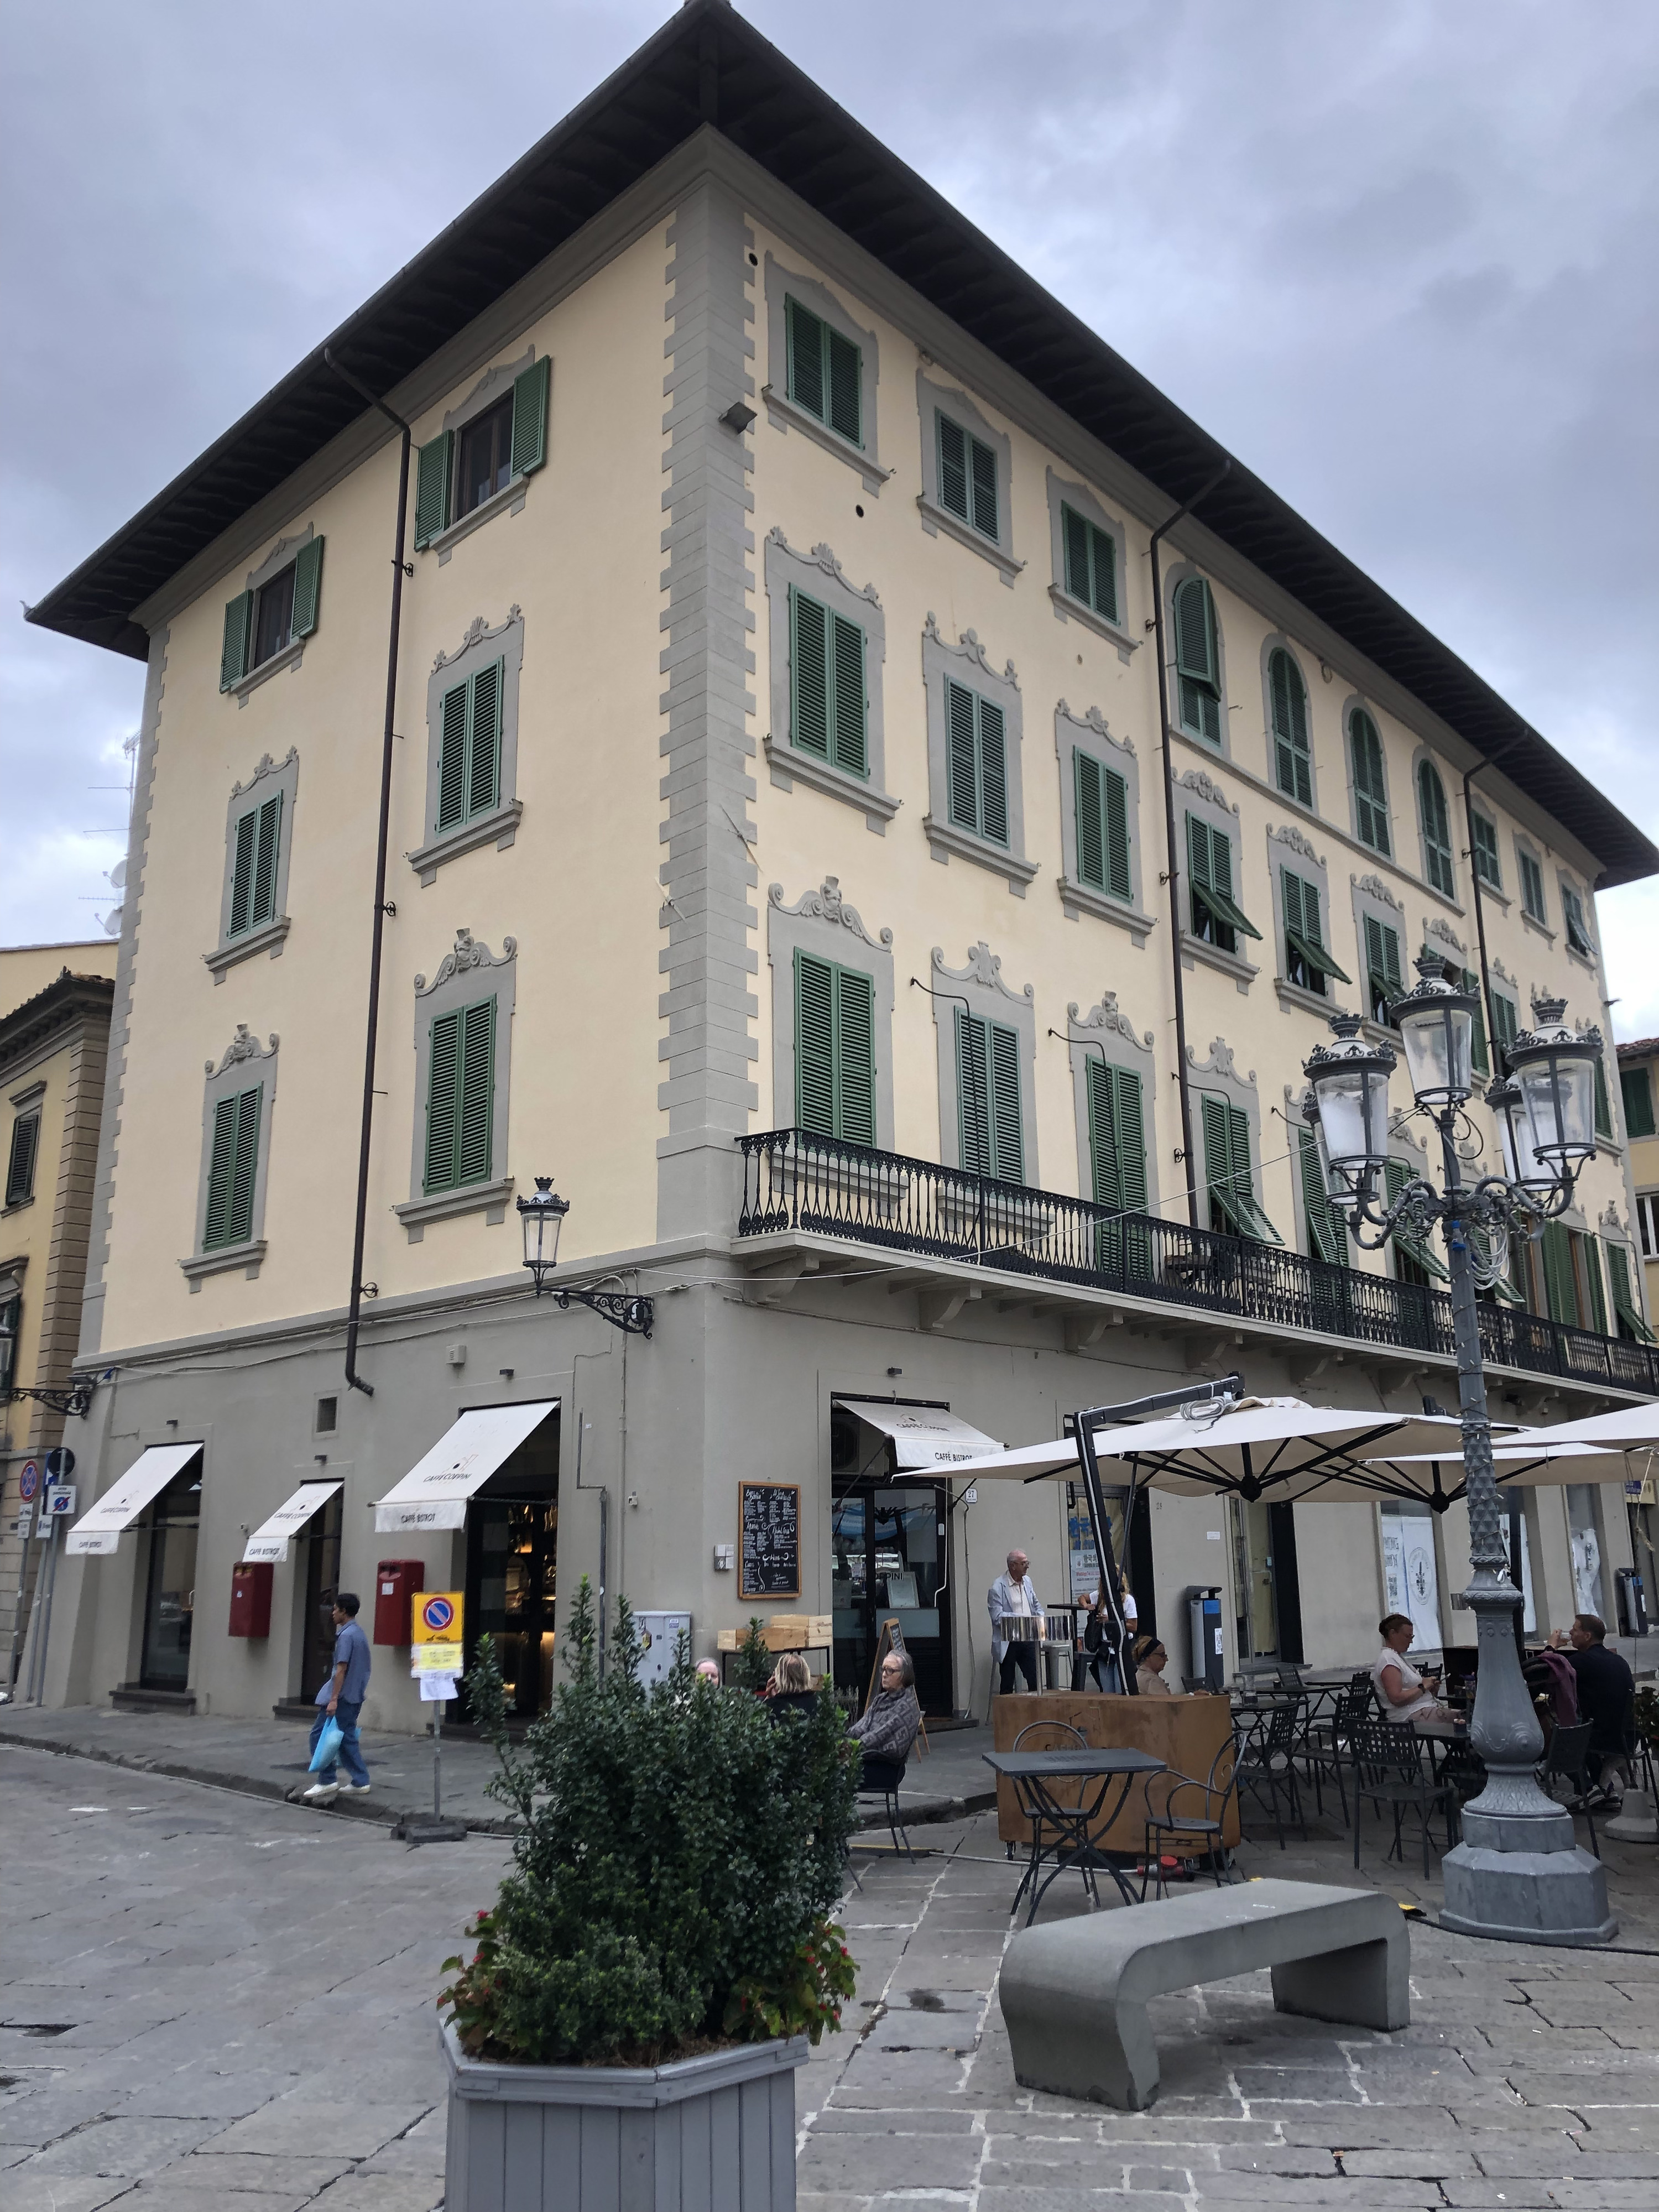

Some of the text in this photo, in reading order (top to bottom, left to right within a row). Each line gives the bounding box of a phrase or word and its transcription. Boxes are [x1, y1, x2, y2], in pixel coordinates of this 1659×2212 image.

[935, 1452, 951, 1462] CAFFÈ
[968, 1490, 974, 1498] 27
[875, 1572, 903, 1580] OPPINI
